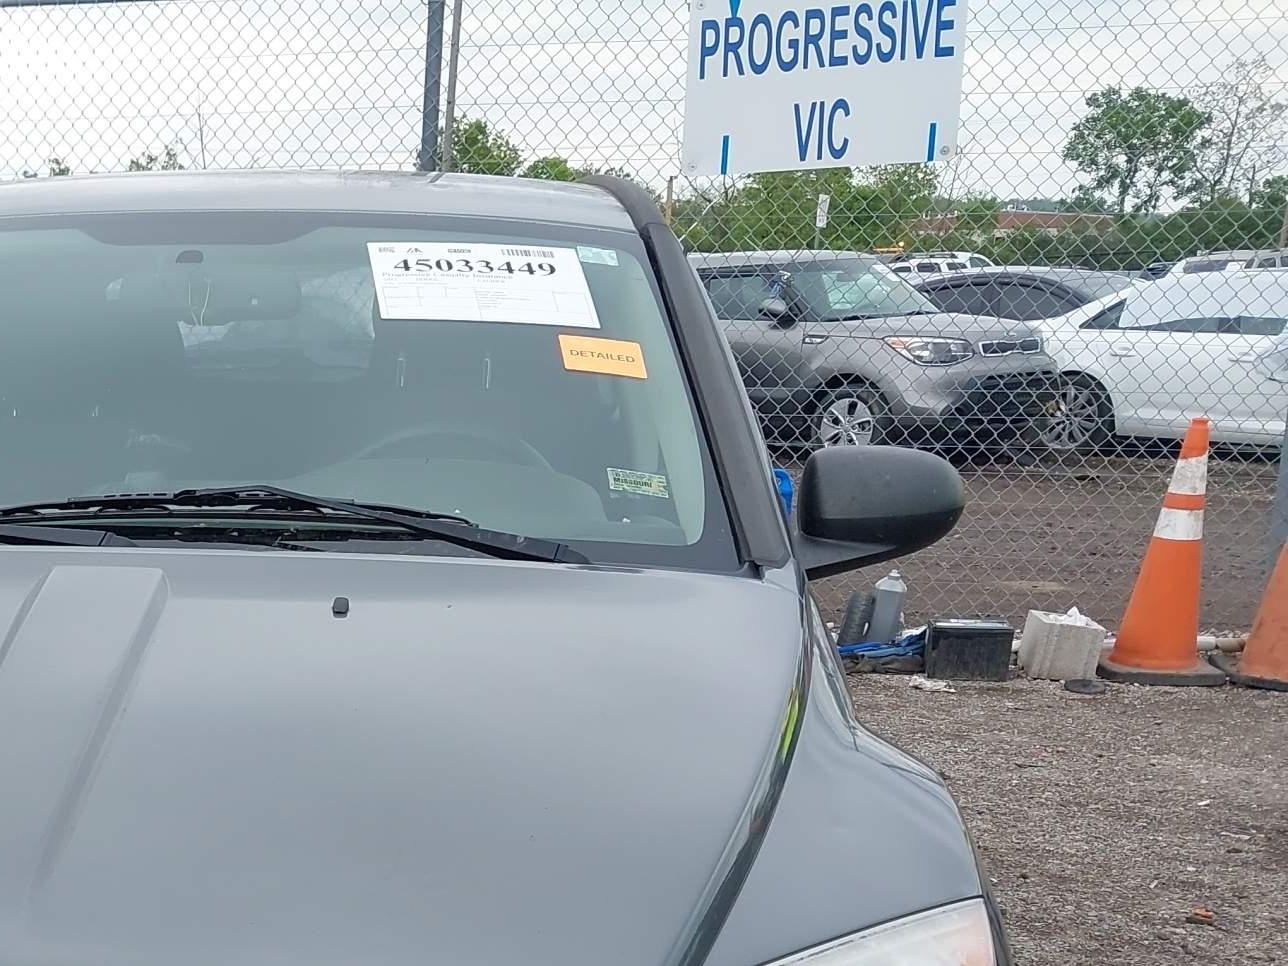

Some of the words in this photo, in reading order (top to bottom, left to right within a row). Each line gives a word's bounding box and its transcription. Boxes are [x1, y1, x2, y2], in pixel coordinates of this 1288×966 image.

[699, 0, 957, 80] PROGRESSIVE
[793, 98, 851, 162] VIC
[393, 258, 556, 277] 45033449
[569, 349, 636, 363] DETAILED
